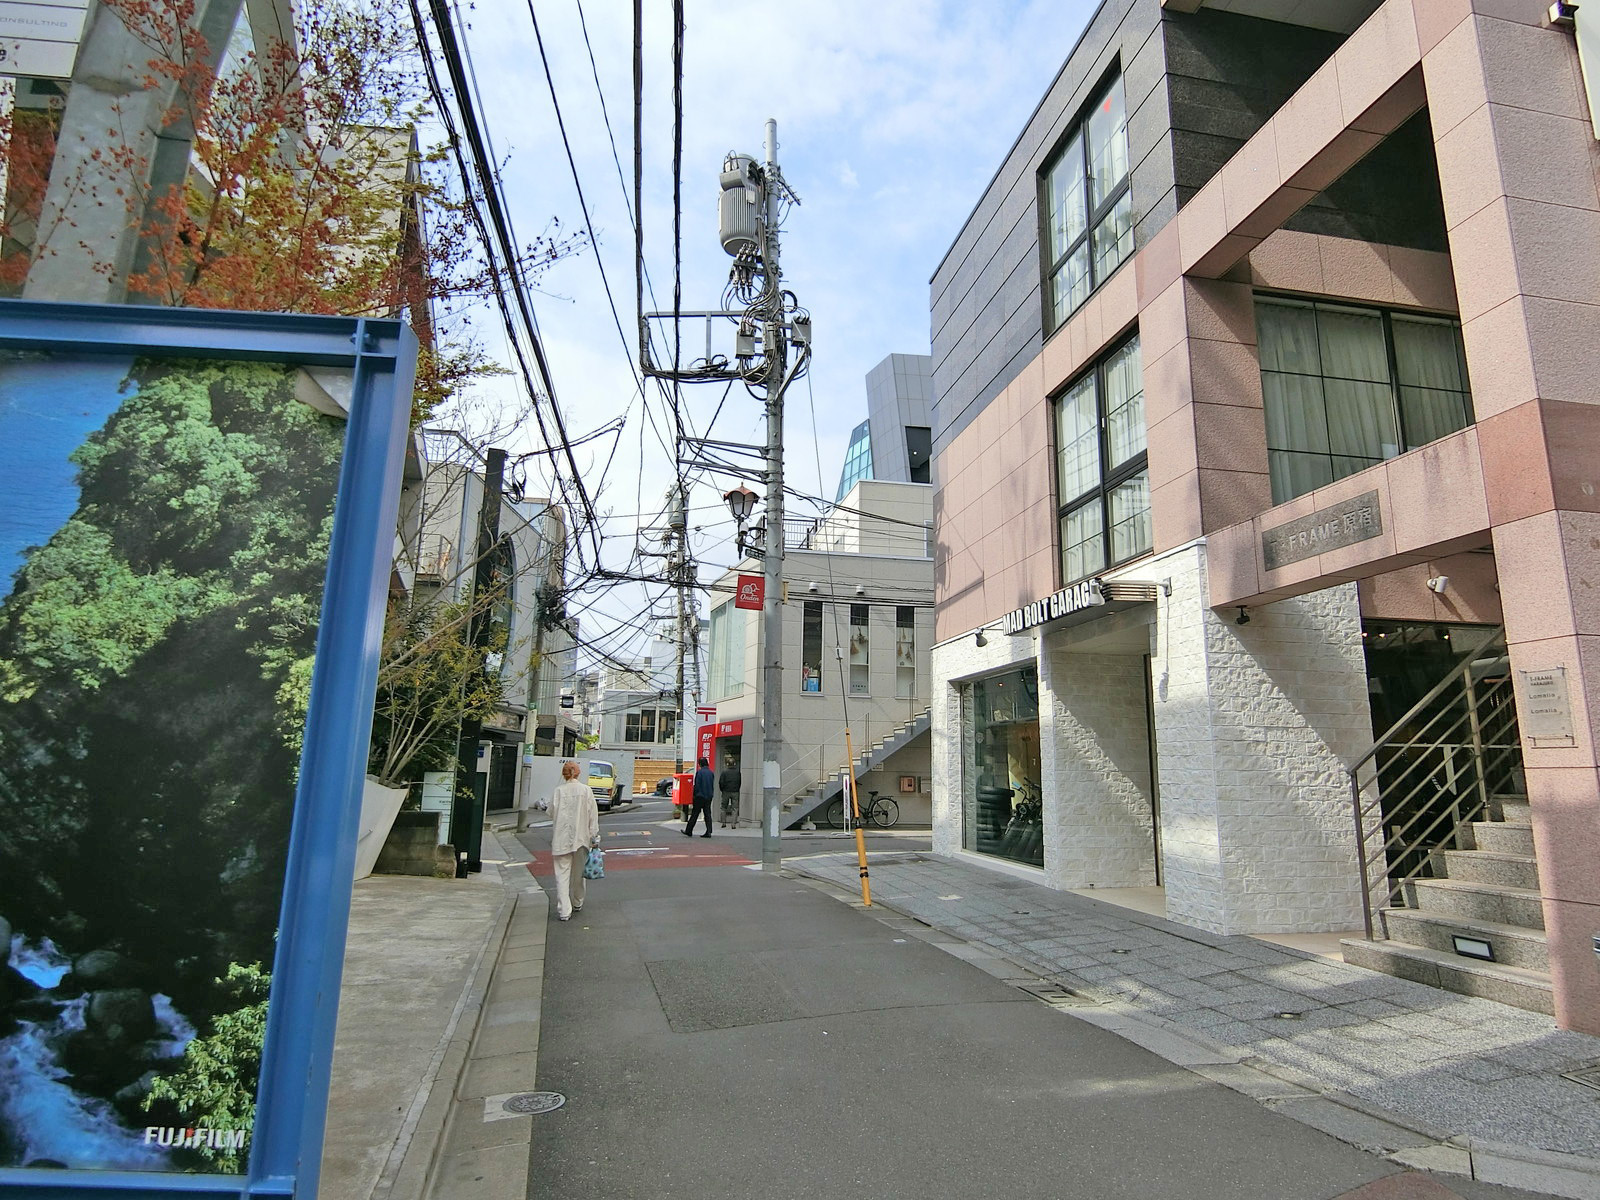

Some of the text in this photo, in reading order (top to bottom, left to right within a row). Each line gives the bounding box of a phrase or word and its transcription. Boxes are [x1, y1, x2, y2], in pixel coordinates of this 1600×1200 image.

[1003, 611, 1023, 635] MAD
[1024, 599, 1049, 628] BOLT
[144, 1126, 246, 1149] FUJIFILM
